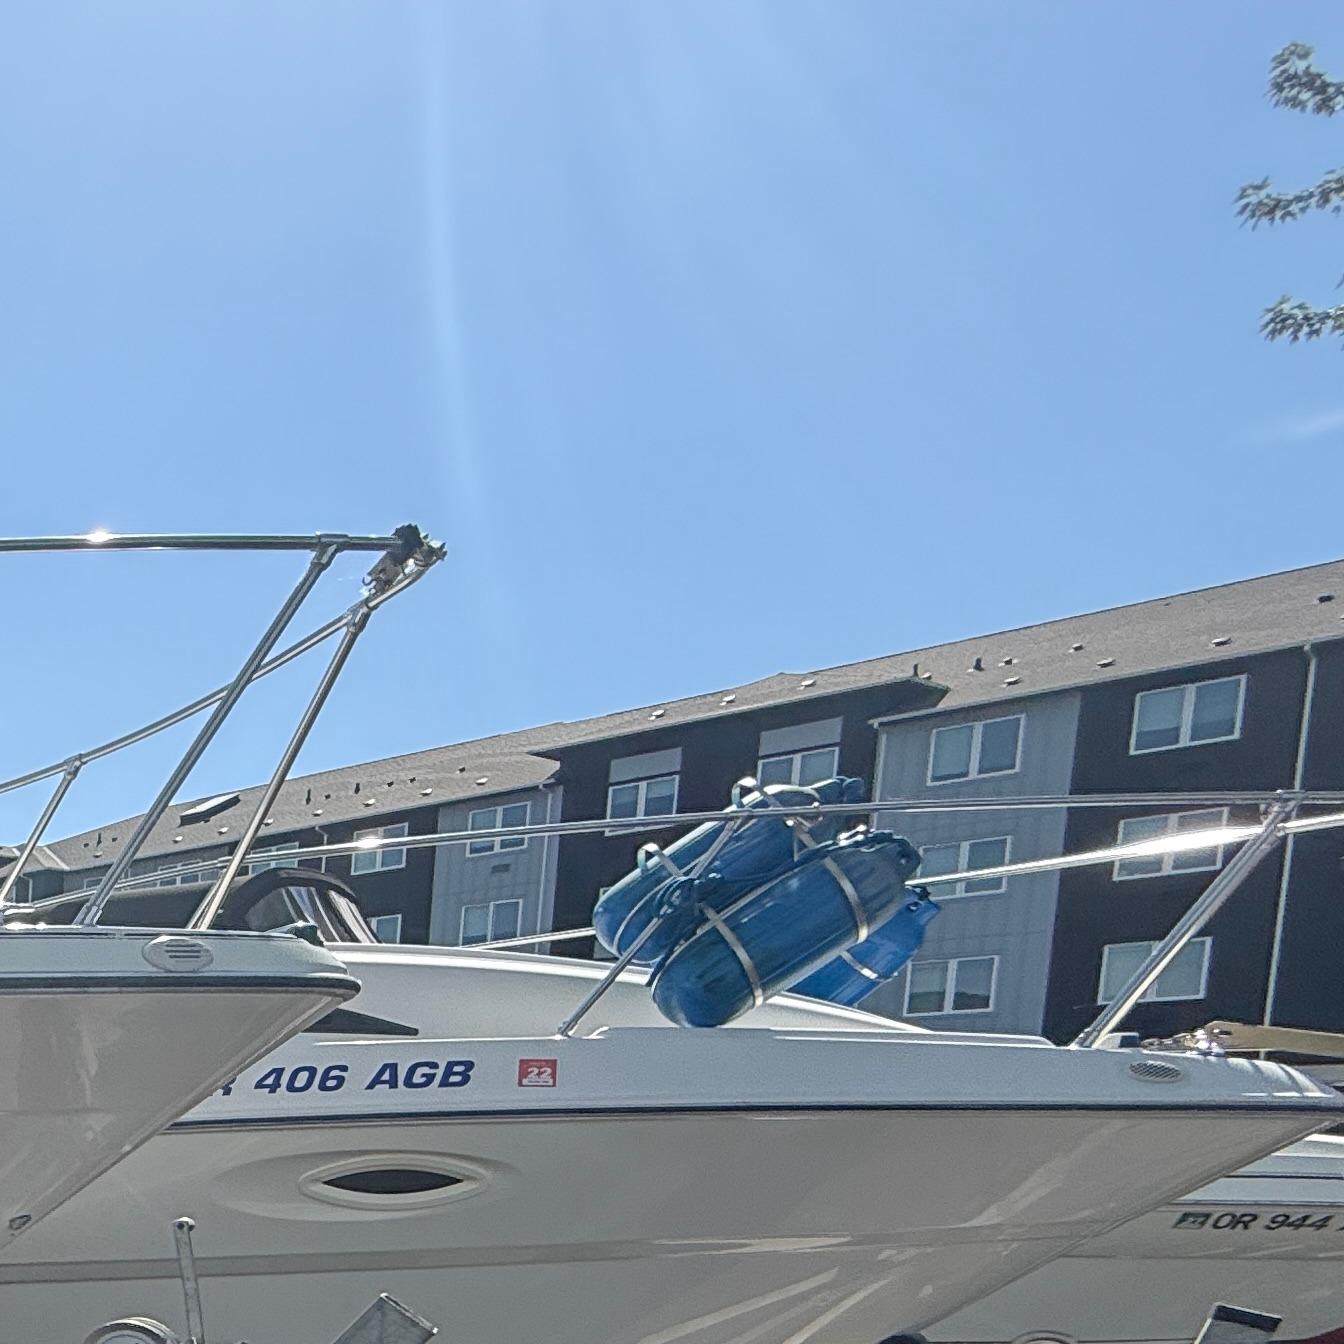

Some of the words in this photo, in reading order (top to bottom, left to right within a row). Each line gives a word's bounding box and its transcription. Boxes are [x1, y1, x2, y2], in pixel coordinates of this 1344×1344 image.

[253, 1064, 349, 1095] 406
[364, 1059, 476, 1090] AGB
[527, 1066, 553, 1080] 22
[1211, 1212, 1258, 1231] OR
[1263, 1213, 1336, 1231] 944
